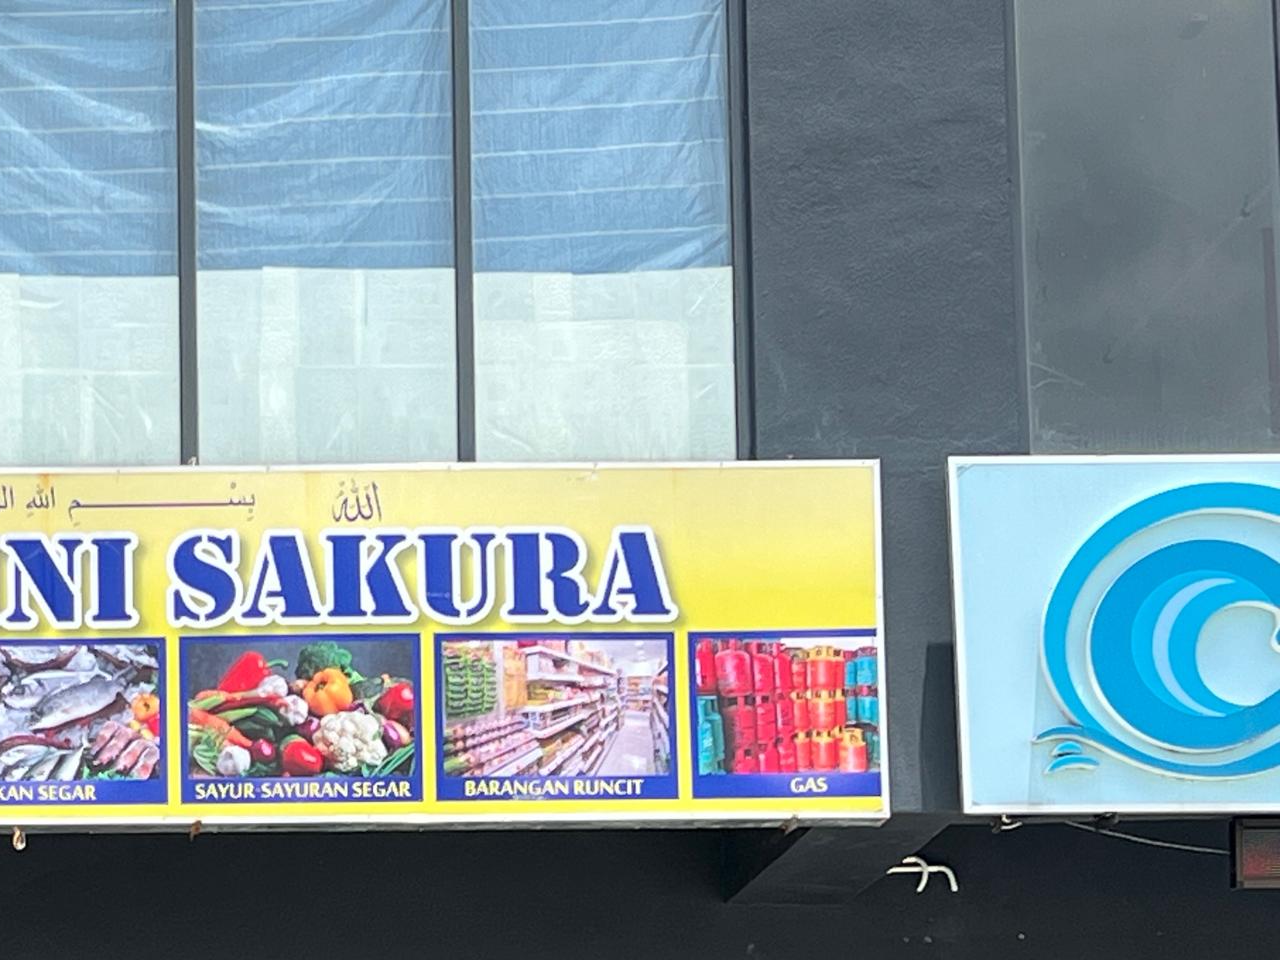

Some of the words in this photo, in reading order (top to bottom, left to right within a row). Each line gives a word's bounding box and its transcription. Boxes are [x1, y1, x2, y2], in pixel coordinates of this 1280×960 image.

[172, 531, 673, 620] SAKURA
[37, 785, 97, 801] SEGAR
[352, 781, 412, 798] SEGAR
[464, 779, 569, 796] BARANGAN
[573, 778, 644, 795] RUNCIT
[790, 777, 828, 793] GAS
